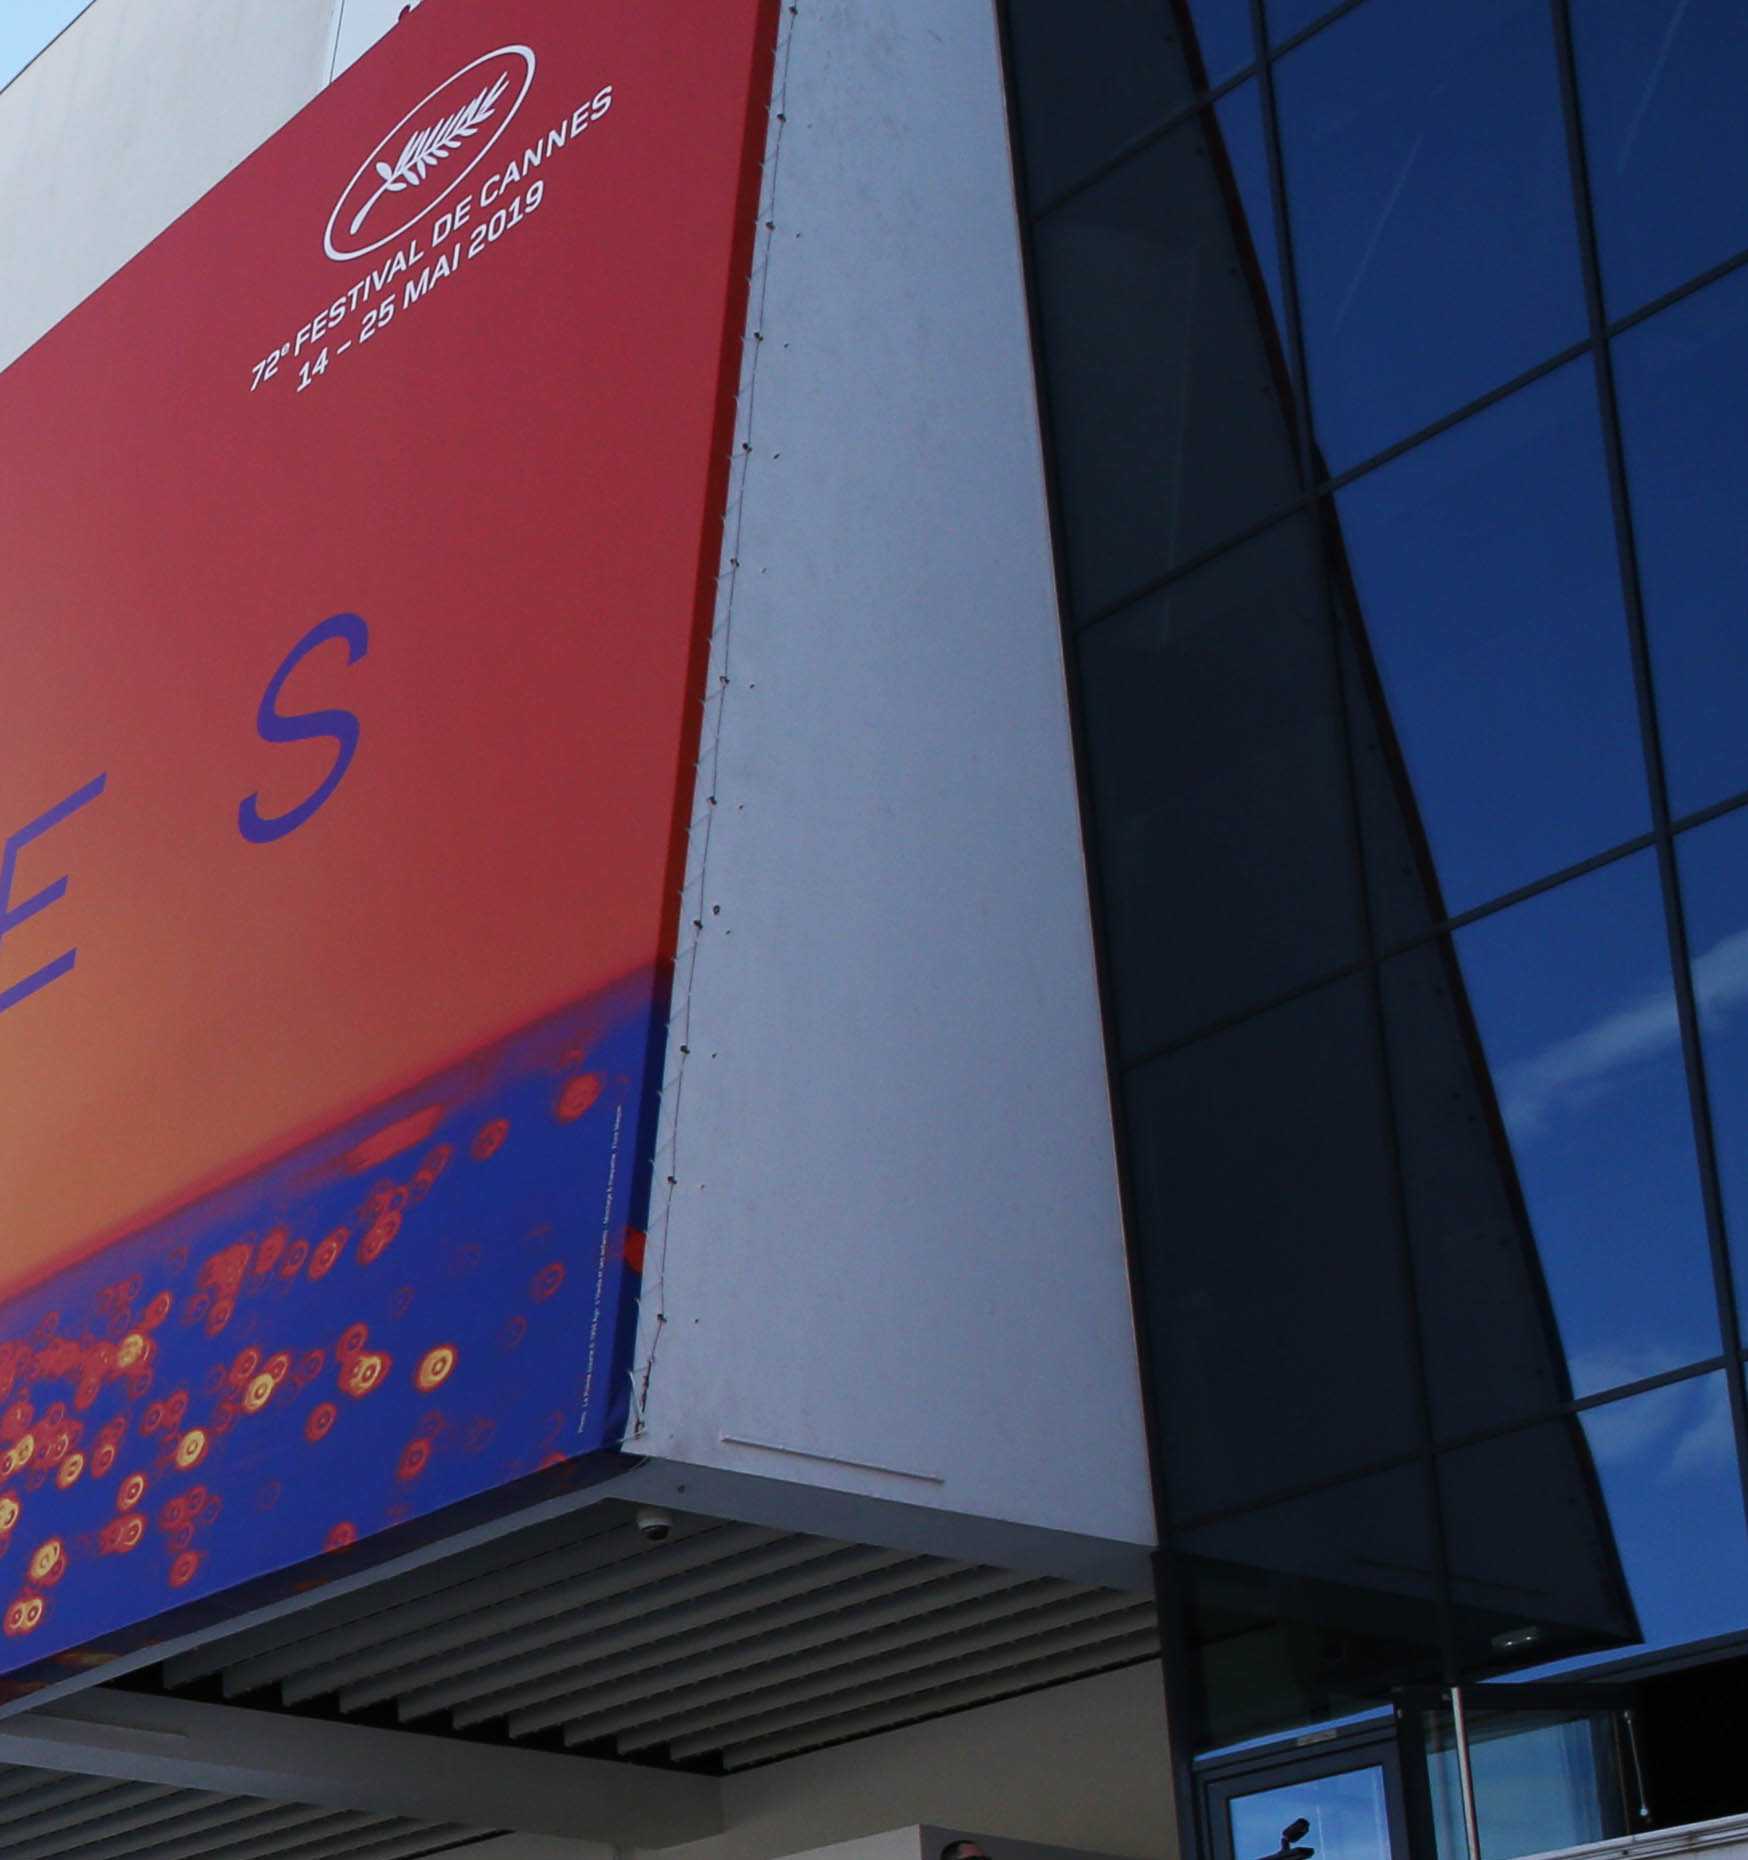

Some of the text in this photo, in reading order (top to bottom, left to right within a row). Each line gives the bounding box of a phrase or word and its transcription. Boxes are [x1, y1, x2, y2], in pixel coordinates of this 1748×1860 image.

[294, 239, 423, 357] FESTIVAL
[431, 195, 473, 247] DE
[479, 85, 613, 208] CANNES
[296, 347, 329, 392] 14
[359, 293, 397, 343] 25
[402, 243, 461, 310] MAI
[467, 179, 545, 261] 2019
